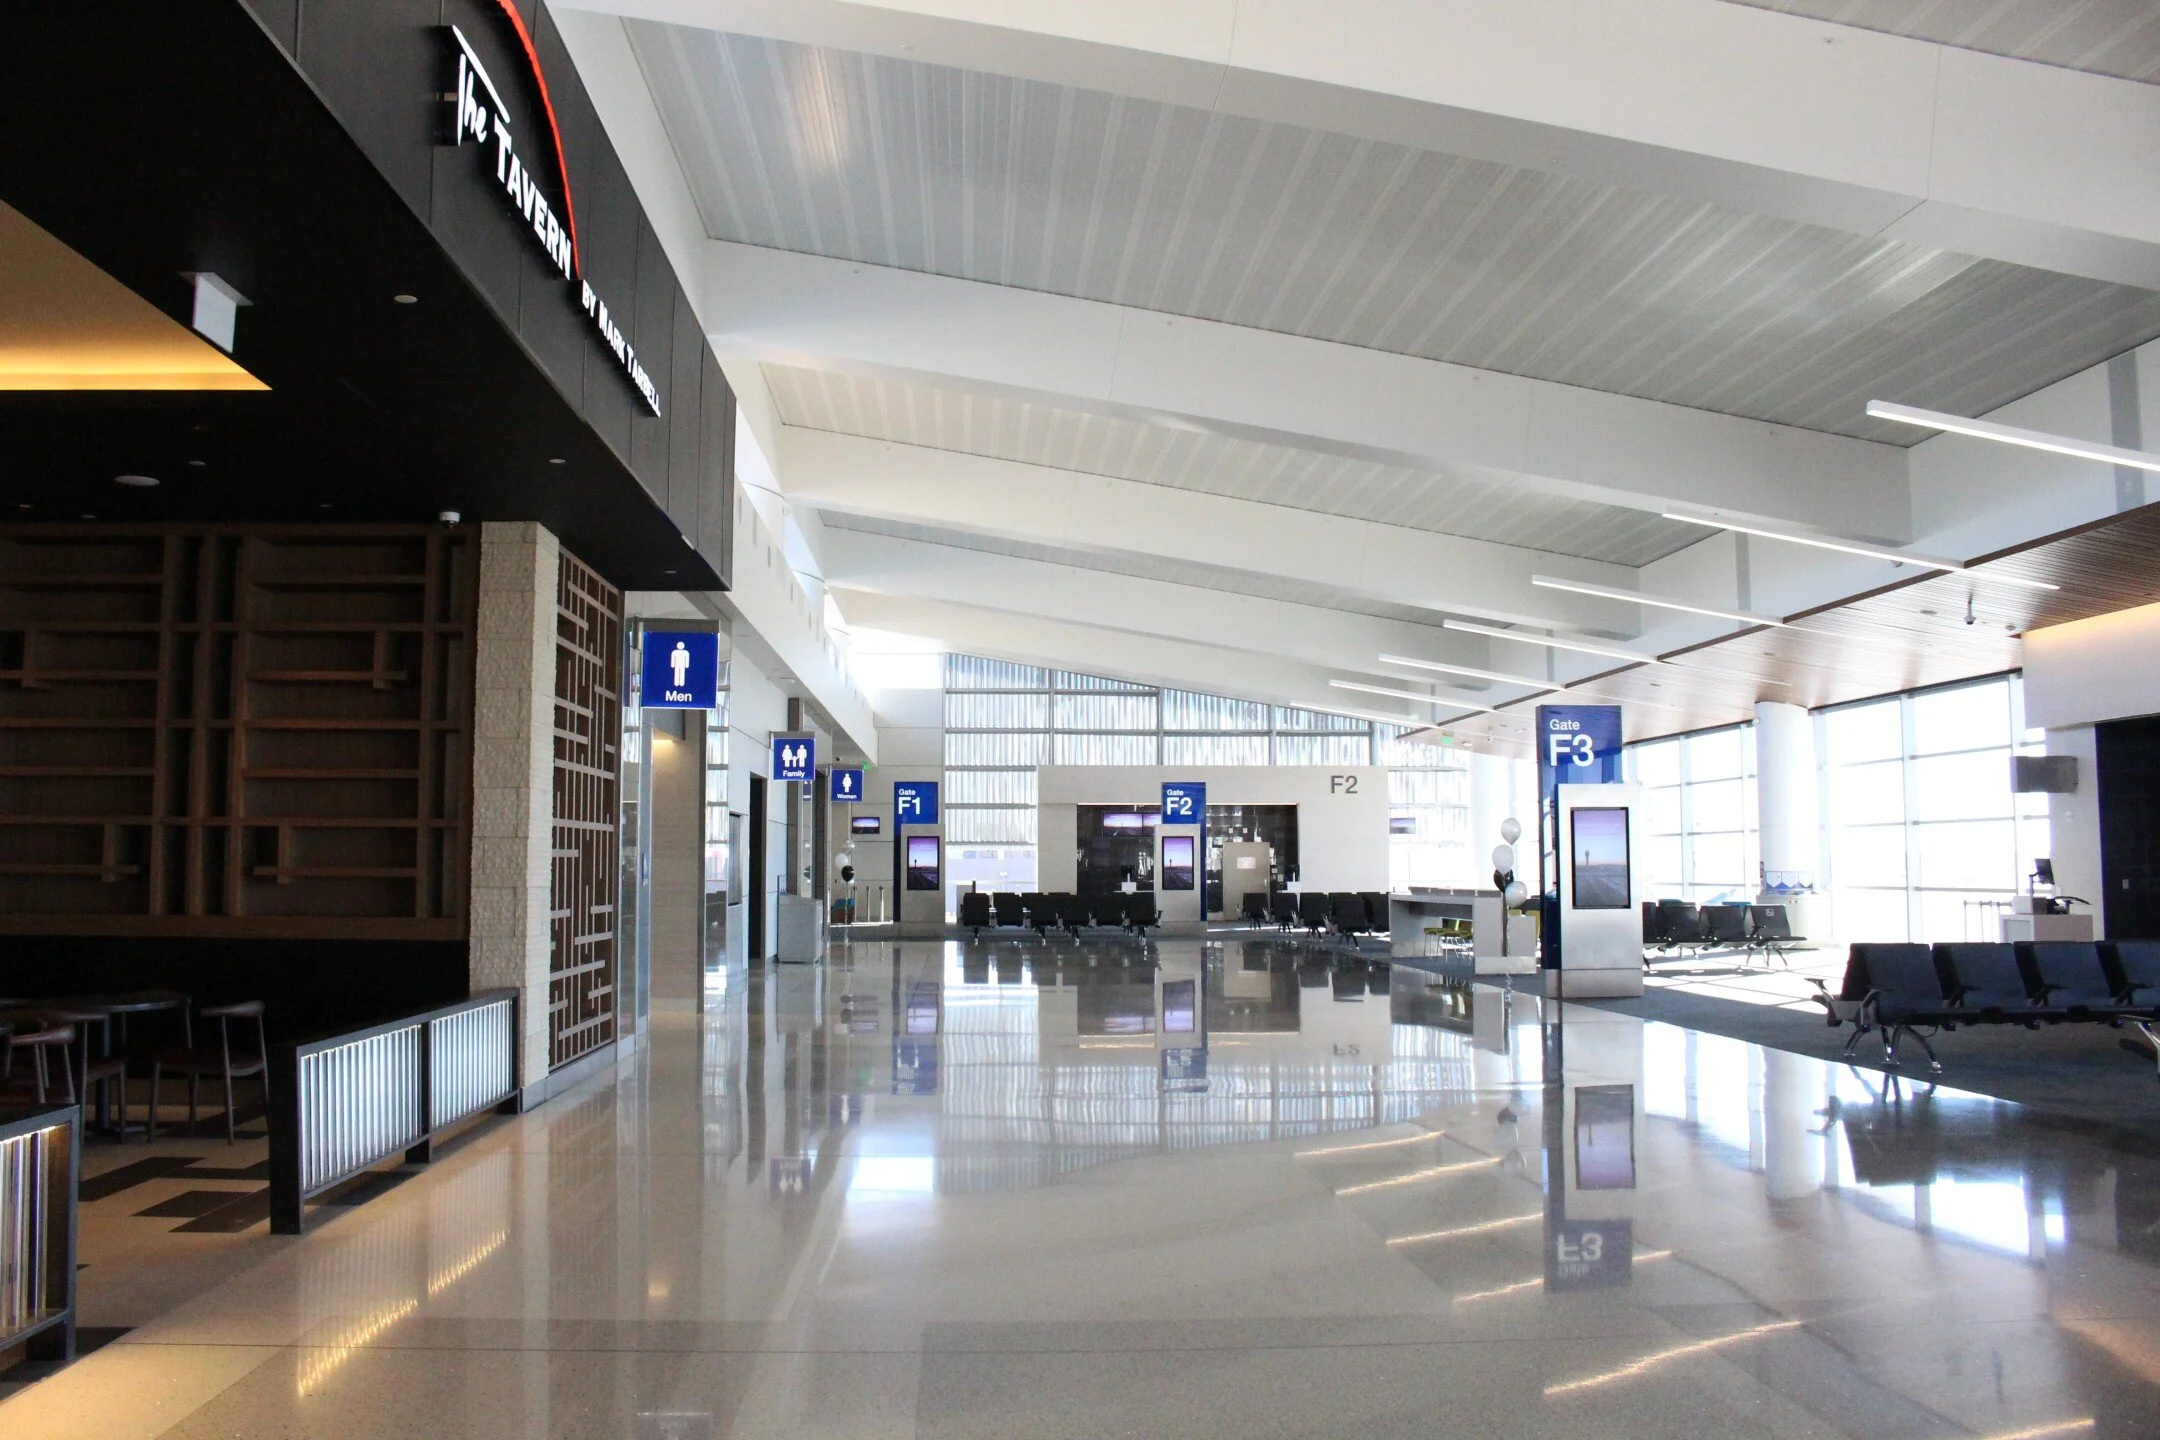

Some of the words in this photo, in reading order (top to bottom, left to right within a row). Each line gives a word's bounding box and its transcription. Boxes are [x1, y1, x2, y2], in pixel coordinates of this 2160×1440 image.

[452, 24, 511, 147] The
[494, 112, 572, 281] TAVERN
[582, 279, 597, 318] BY
[598, 300, 626, 364] MARK
[626, 343, 661, 418] TARBELL
[665, 690, 692, 702] Men
[1549, 718, 1581, 731] Gate
[1549, 733, 1595, 767] F3
[782, 770, 806, 779] Family
[898, 788, 916, 796] Gate
[1166, 788, 1184, 796] Gate
[1330, 775, 1358, 794] F2
[898, 797, 921, 815] F1
[1166, 797, 1193, 815] F2
